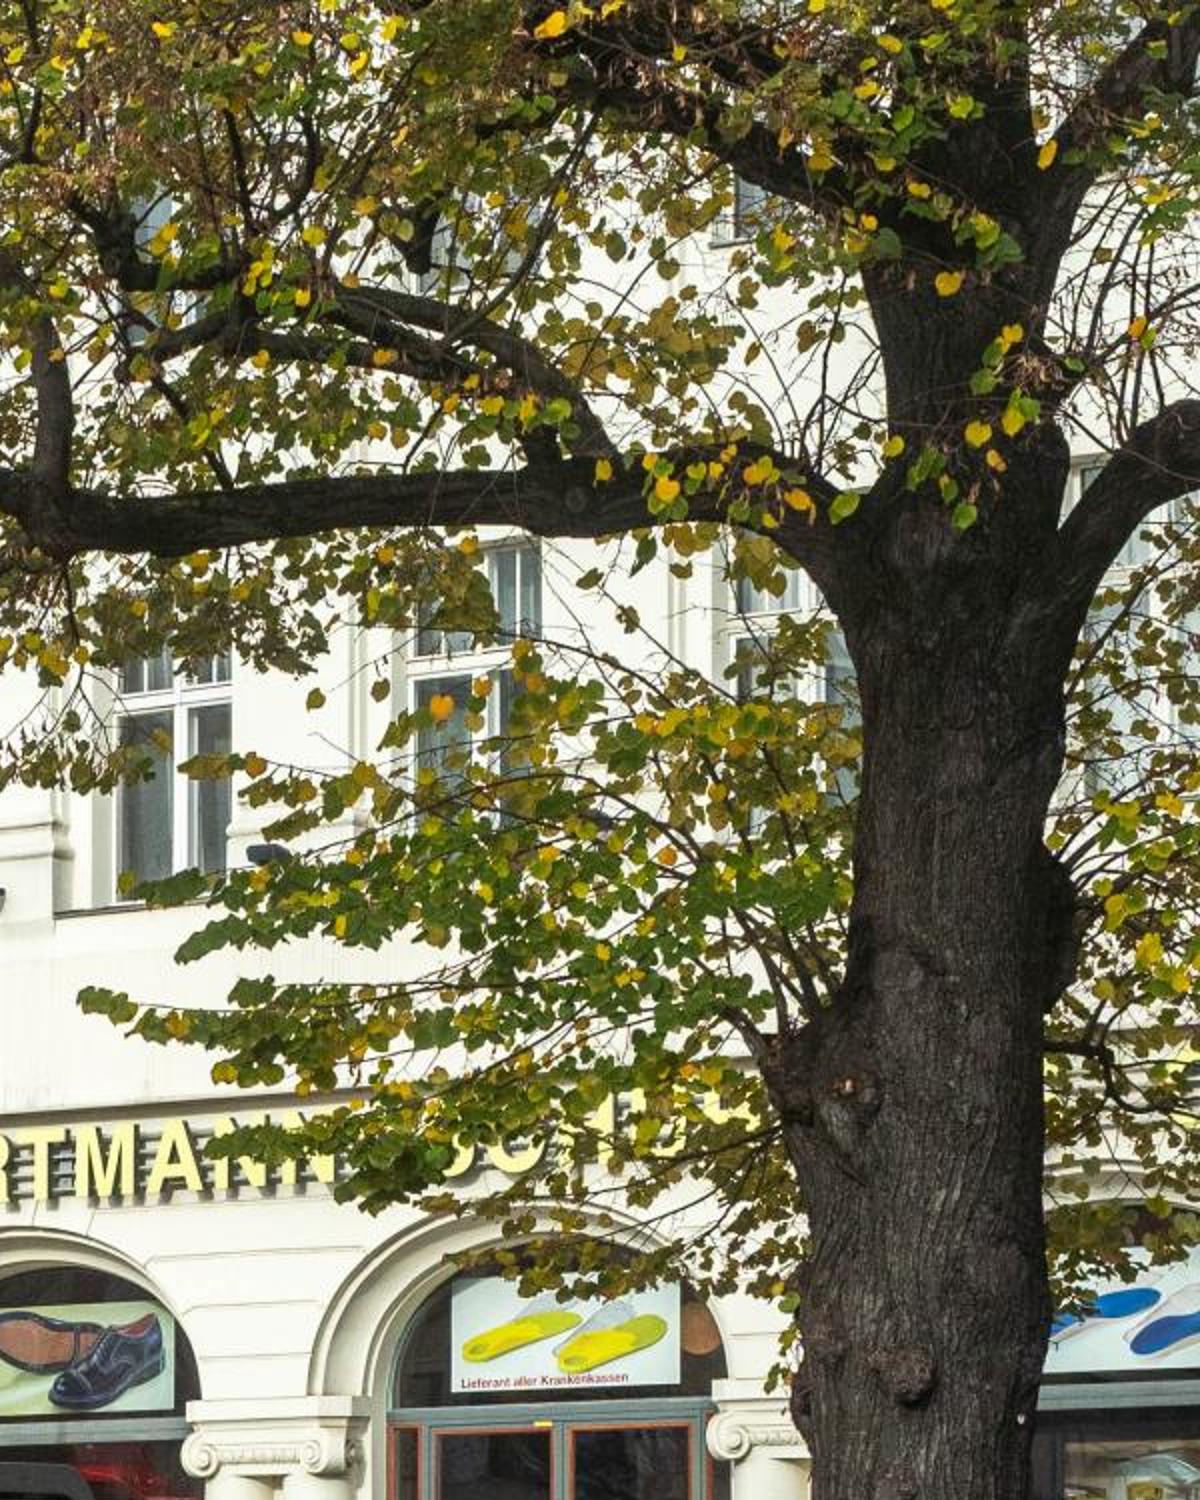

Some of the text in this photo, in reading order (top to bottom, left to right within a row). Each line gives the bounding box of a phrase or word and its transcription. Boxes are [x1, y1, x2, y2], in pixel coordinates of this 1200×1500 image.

[461, 1373, 629, 1389] Lieferant aller Krankenkassen
